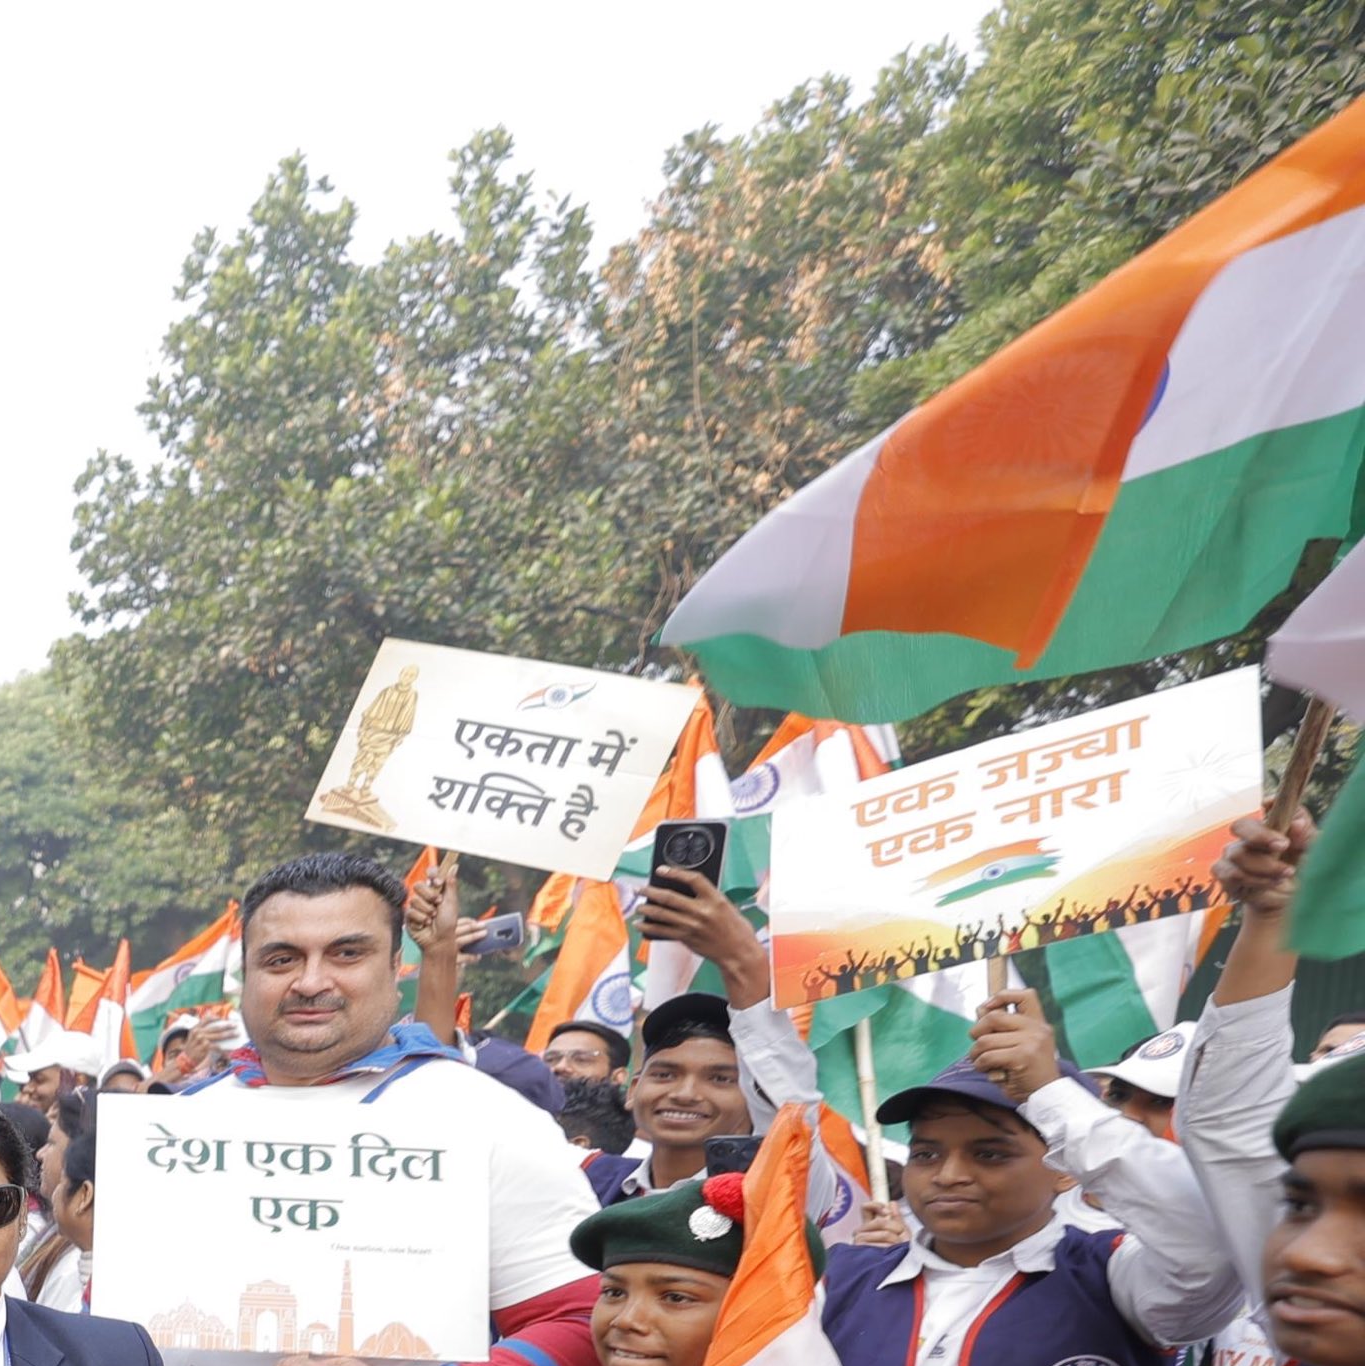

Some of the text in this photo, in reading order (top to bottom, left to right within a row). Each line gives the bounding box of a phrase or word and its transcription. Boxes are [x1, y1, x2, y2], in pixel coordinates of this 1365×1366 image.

[454, 718, 639, 777] एकता में
[427, 771, 599, 841] शक्ति है
[851, 770, 959, 828] एक
[865, 768, 1131, 868] एक नारा
[145, 1122, 448, 1183] देश एक दिल
[249, 1196, 344, 1233] एक
